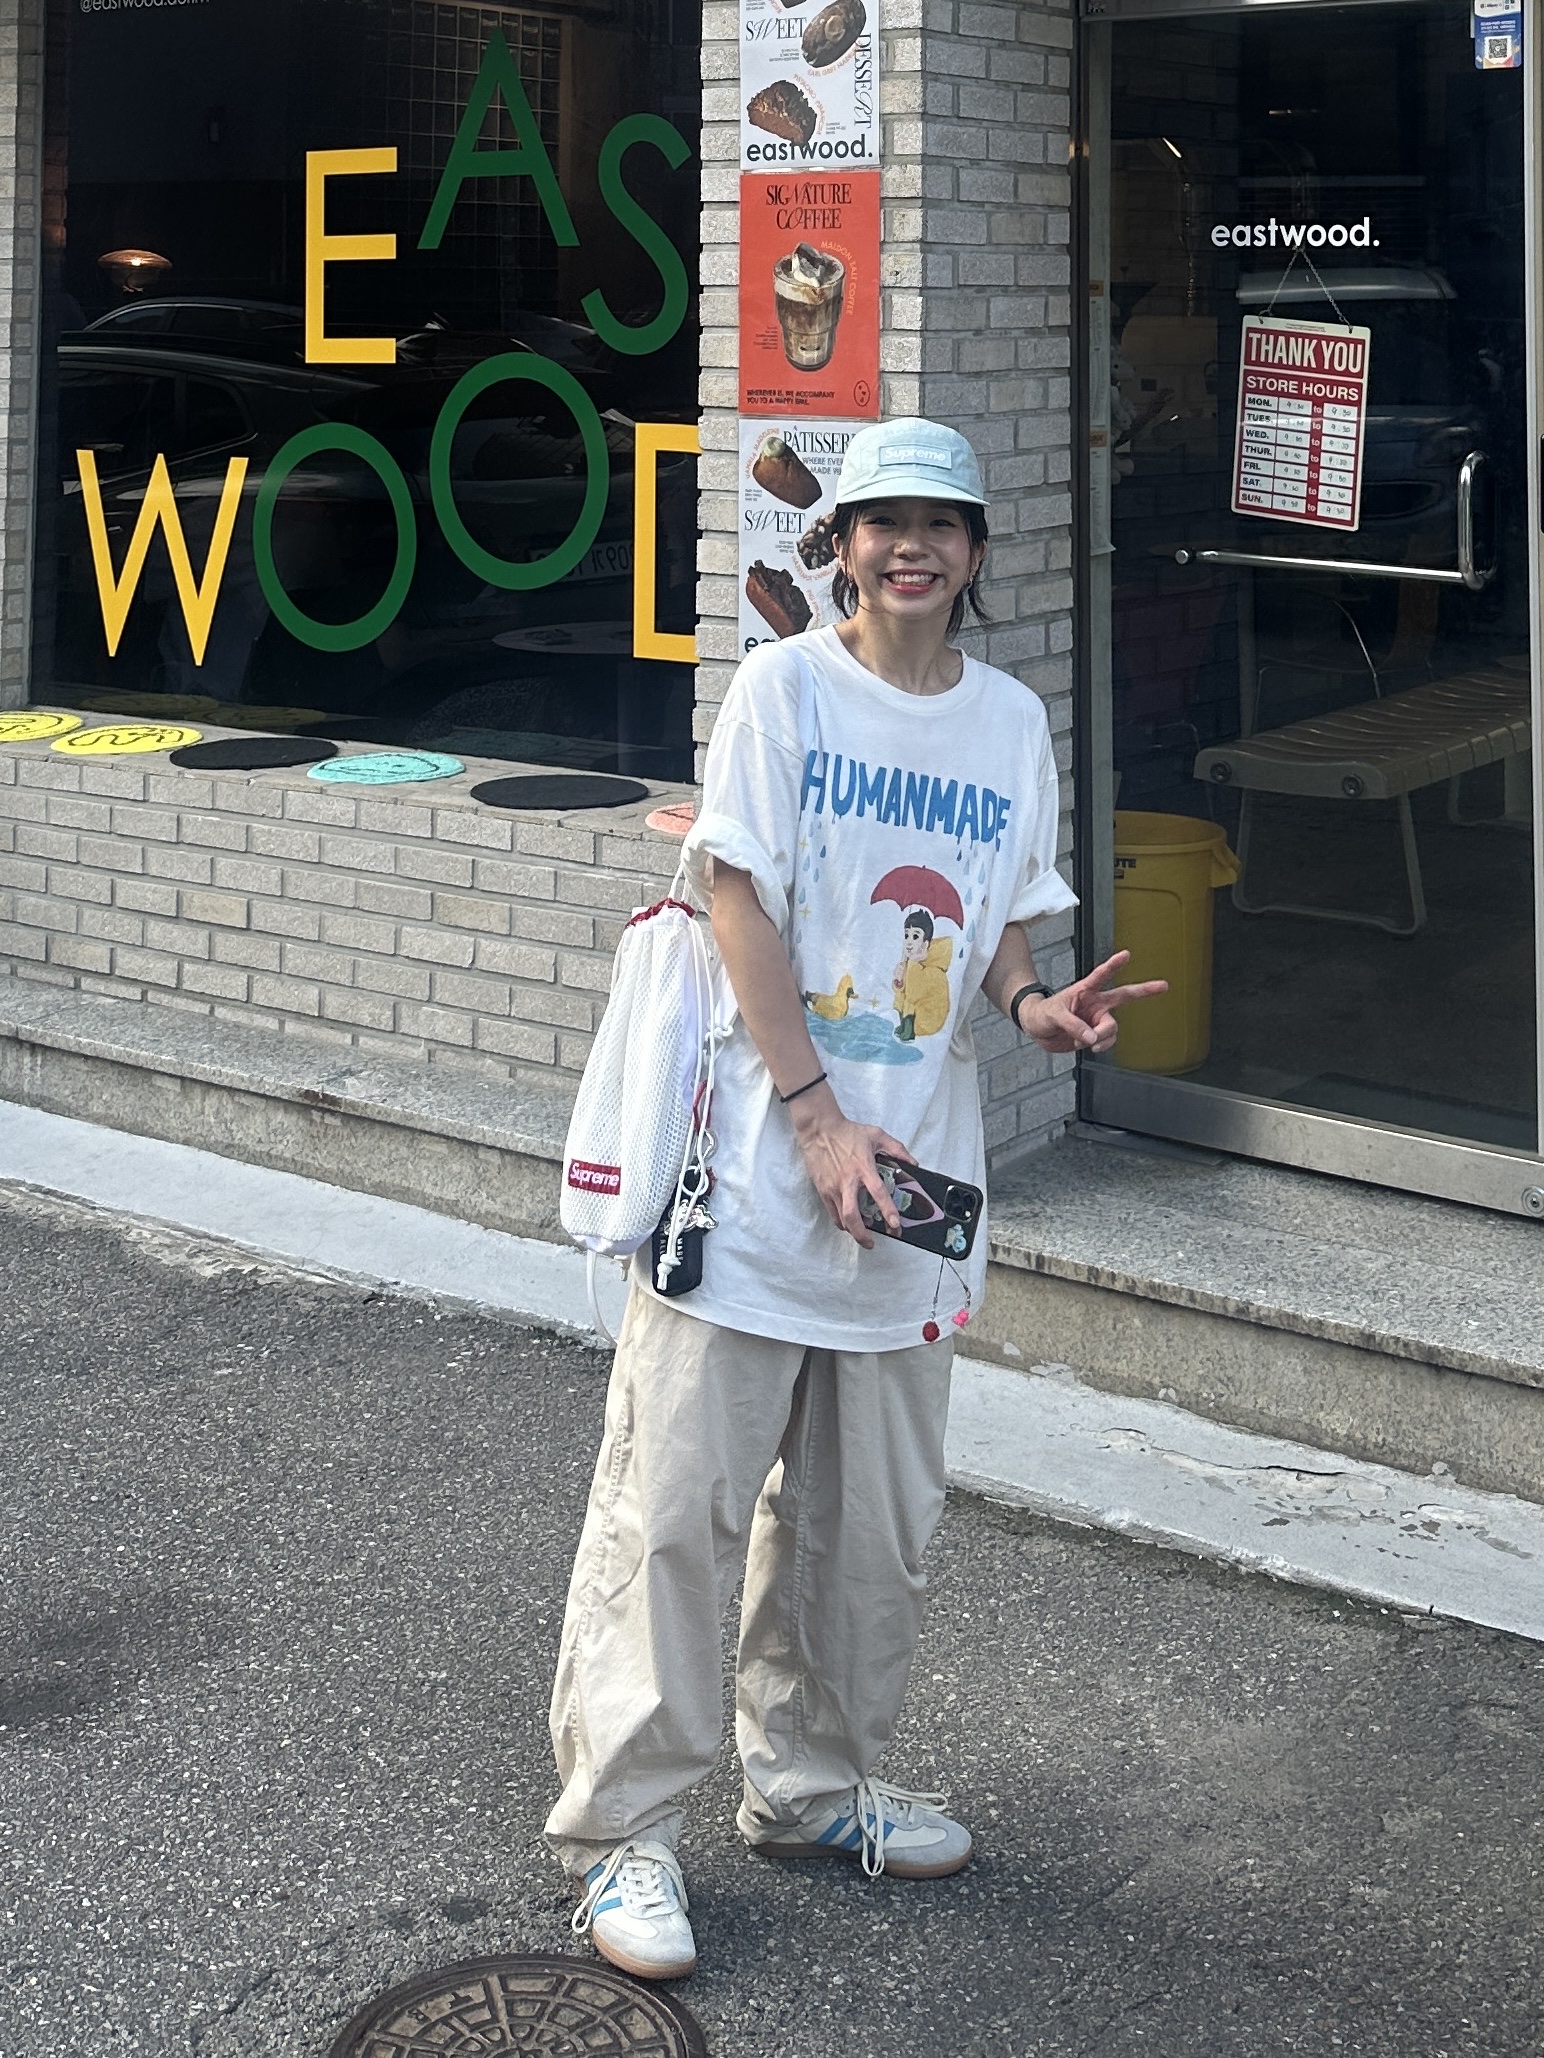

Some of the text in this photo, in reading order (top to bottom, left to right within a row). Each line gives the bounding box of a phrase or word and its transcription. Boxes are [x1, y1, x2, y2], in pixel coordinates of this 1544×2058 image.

[746, 17, 807, 41] SWEET
[854, 33, 872, 129] DESSERT
[747, 134, 873, 161] eastwood.
[766, 182, 852, 205] SIGNATURE
[777, 207, 842, 229] COFFEE
[1211, 217, 1380, 247] eastwood.
[1248, 333, 1363, 373] THANK YOU
[1246, 376, 1359, 400] STORE HOURS
[1247, 397, 1272, 407] MON.
[1313, 406, 1322, 414] to
[1246, 413, 1274, 424] TUES.
[1312, 421, 1321, 429] to
[1245, 428, 1270, 440] WED.
[1311, 438, 1320, 447] to
[884, 447, 946, 461] Supreme
[1244, 444, 1272, 456] THUR.
[1310, 454, 1319, 463] to
[1309, 470, 1318, 479] to
[1308, 487, 1317, 495] to
[1241, 493, 1263, 504] SUN.
[1307, 503, 1316, 512] to
[744, 510, 806, 533] SWEET
[569, 1163, 620, 1186] Supreme
